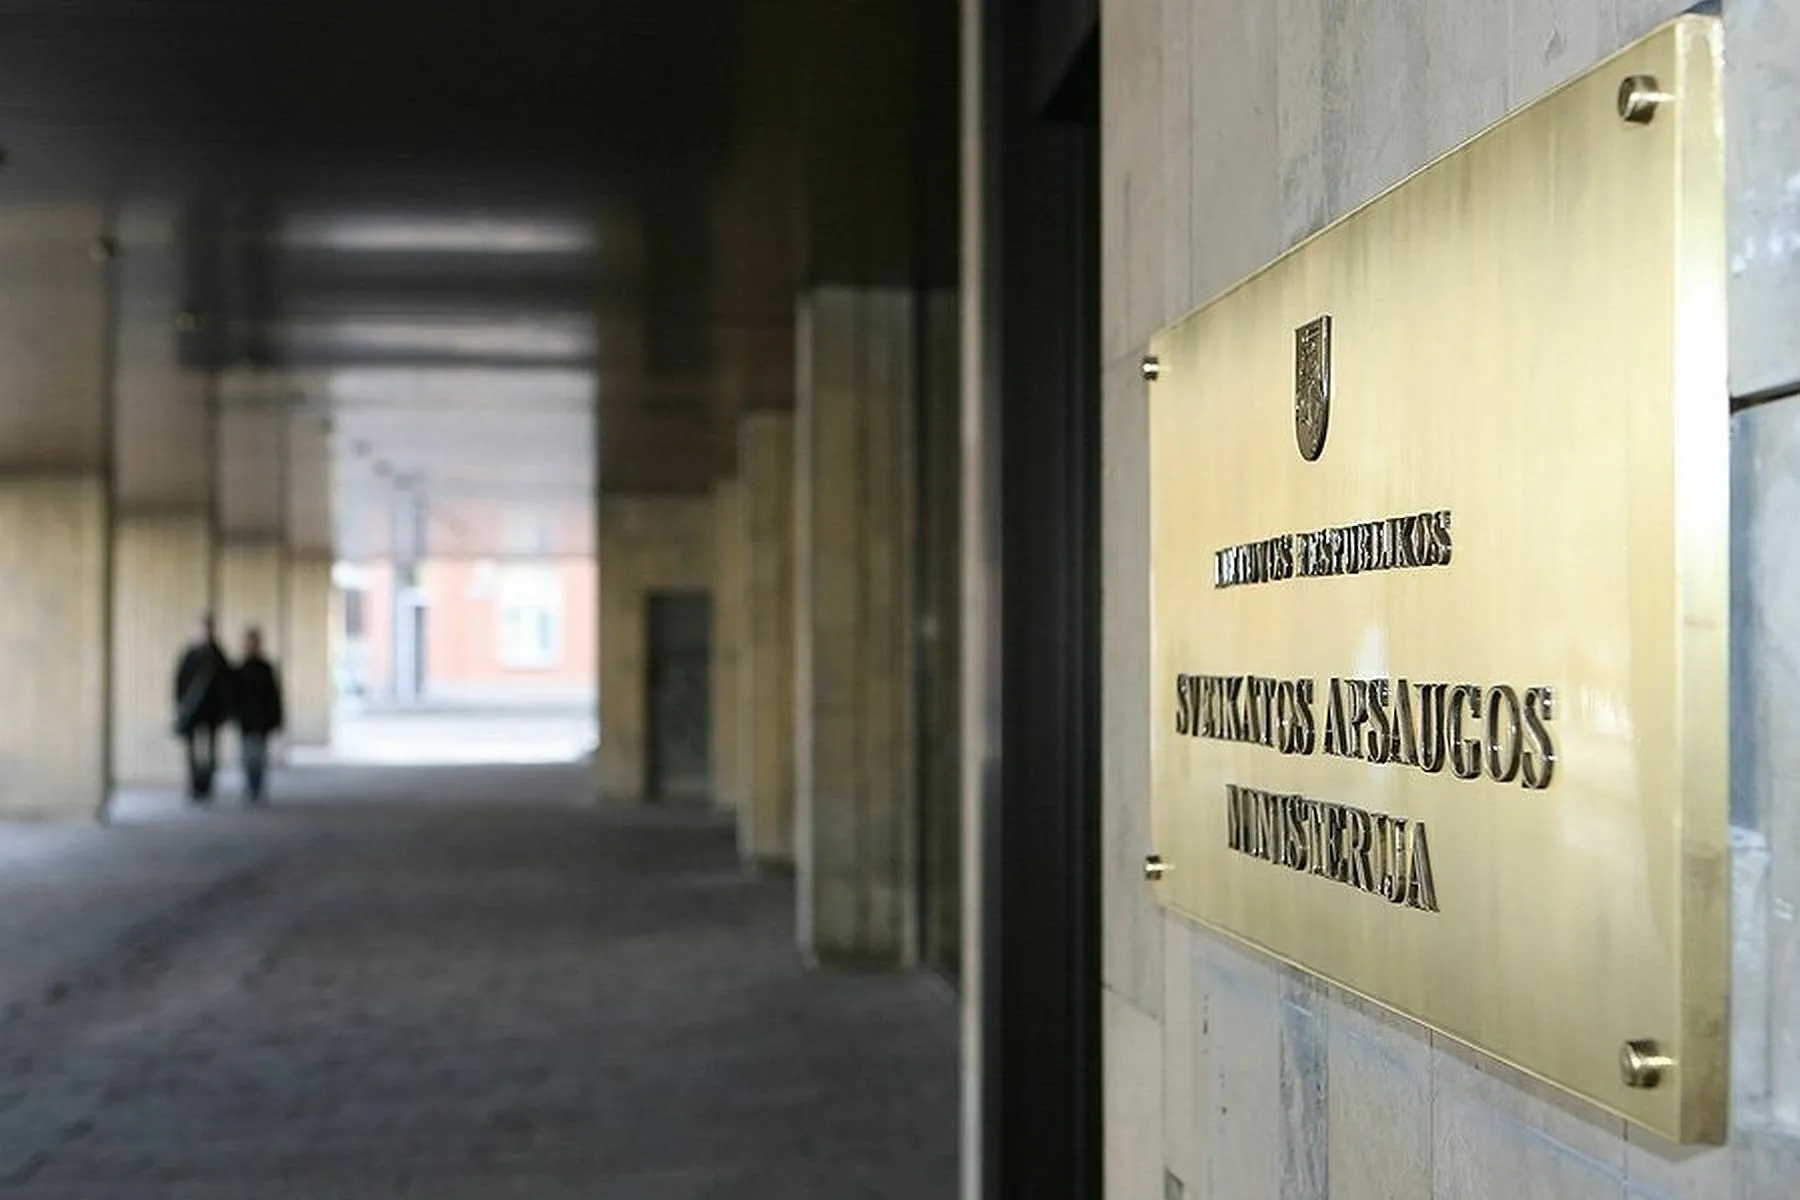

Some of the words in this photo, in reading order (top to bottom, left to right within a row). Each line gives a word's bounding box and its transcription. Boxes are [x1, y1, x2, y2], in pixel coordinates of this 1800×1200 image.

[1176, 674, 1315, 755] SVEIKATOS
[1323, 677, 1556, 789] APSAUGOS
[1226, 784, 1440, 913] MINISTERIJA
